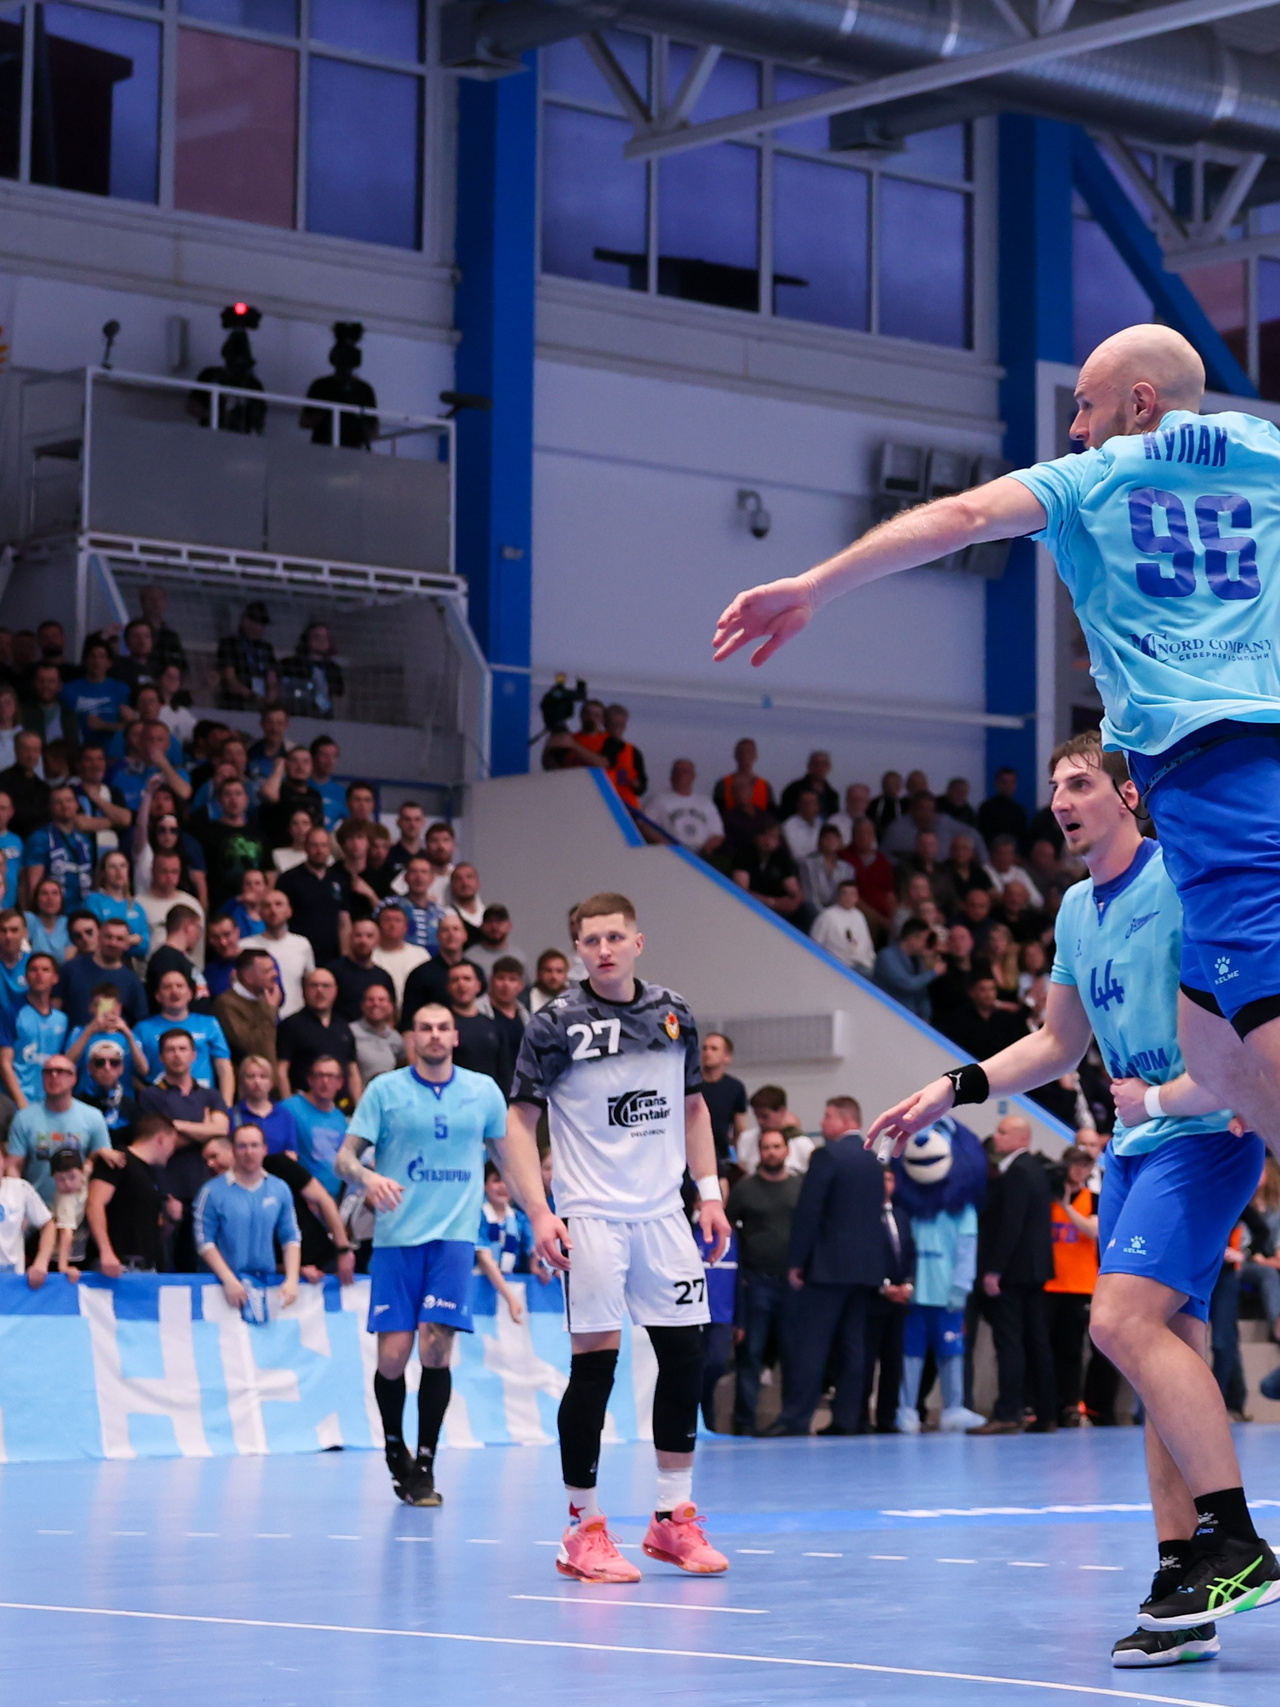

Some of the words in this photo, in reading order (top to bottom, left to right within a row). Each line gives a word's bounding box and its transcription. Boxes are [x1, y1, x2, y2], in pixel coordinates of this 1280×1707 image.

[1142, 423, 1228, 467] КУЛАК
[1129, 487, 1261, 600] 96
[1158, 638, 1204, 654] NORD
[1209, 638, 1273, 654] COMPANY
[1090, 958, 1124, 1011] 44
[566, 1018, 621, 1061] 27
[434, 1114, 448, 1140] 5
[673, 1278, 704, 1305] 27
